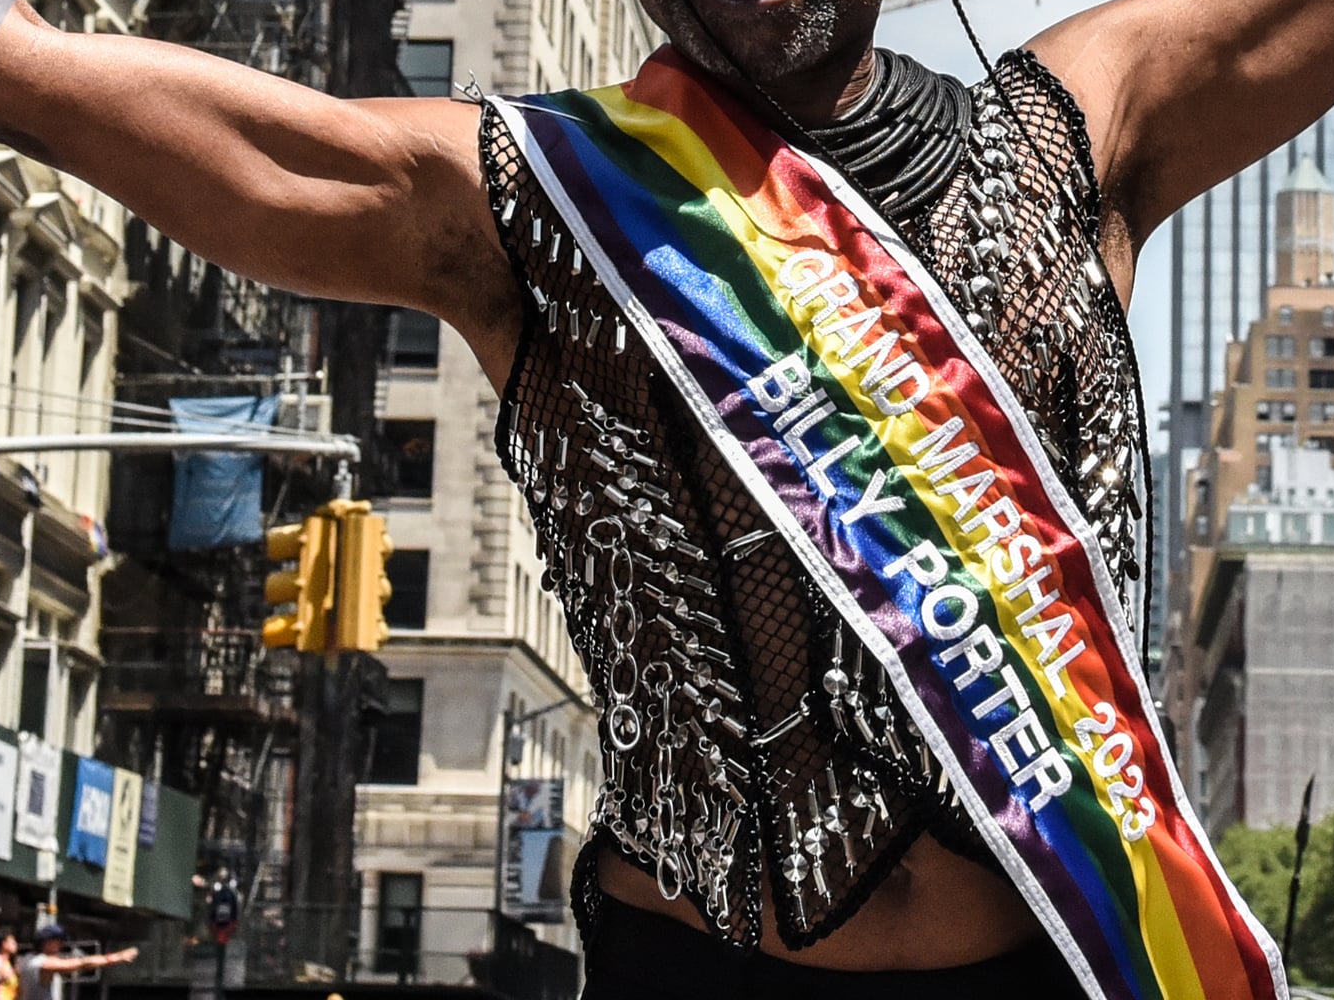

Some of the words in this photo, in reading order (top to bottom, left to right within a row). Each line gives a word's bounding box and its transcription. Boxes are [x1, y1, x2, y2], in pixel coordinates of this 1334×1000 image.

[747, 354, 907, 526] BILLY
[883, 540, 1074, 811] PORTER
[776, 249, 929, 415] GRAND
[909, 415, 1089, 698] MARSHAL
[1072, 701, 1156, 843] 2023
